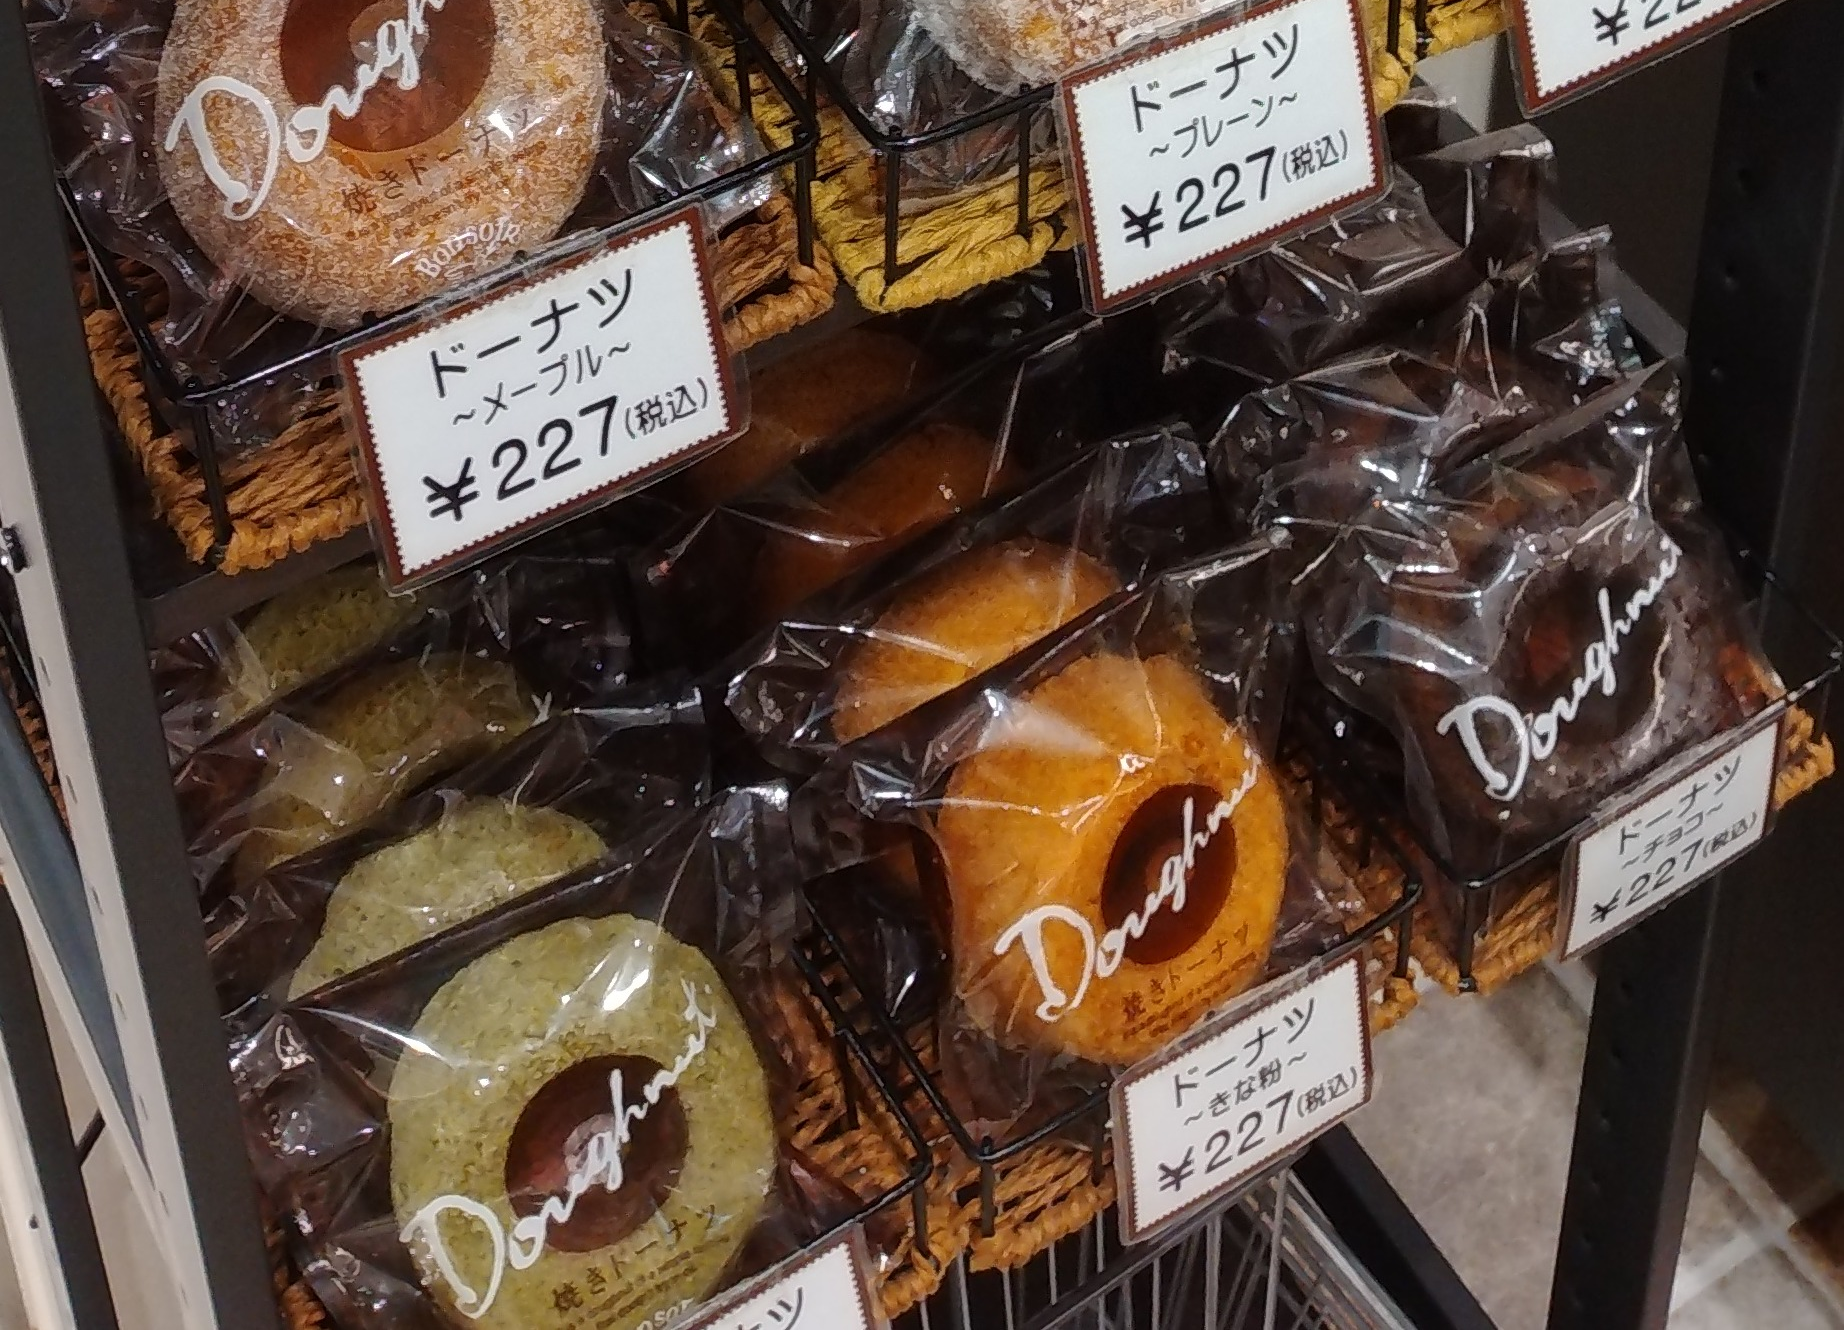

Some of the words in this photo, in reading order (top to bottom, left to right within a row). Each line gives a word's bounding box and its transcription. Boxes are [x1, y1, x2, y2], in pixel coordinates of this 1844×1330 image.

[1129, 23, 1301, 134] ドーナツ
[430, 267, 635, 399] ドーナツ
[1618, 754, 1741, 856] ドーナツ
[1173, 997, 1316, 1109] ドーナツ
